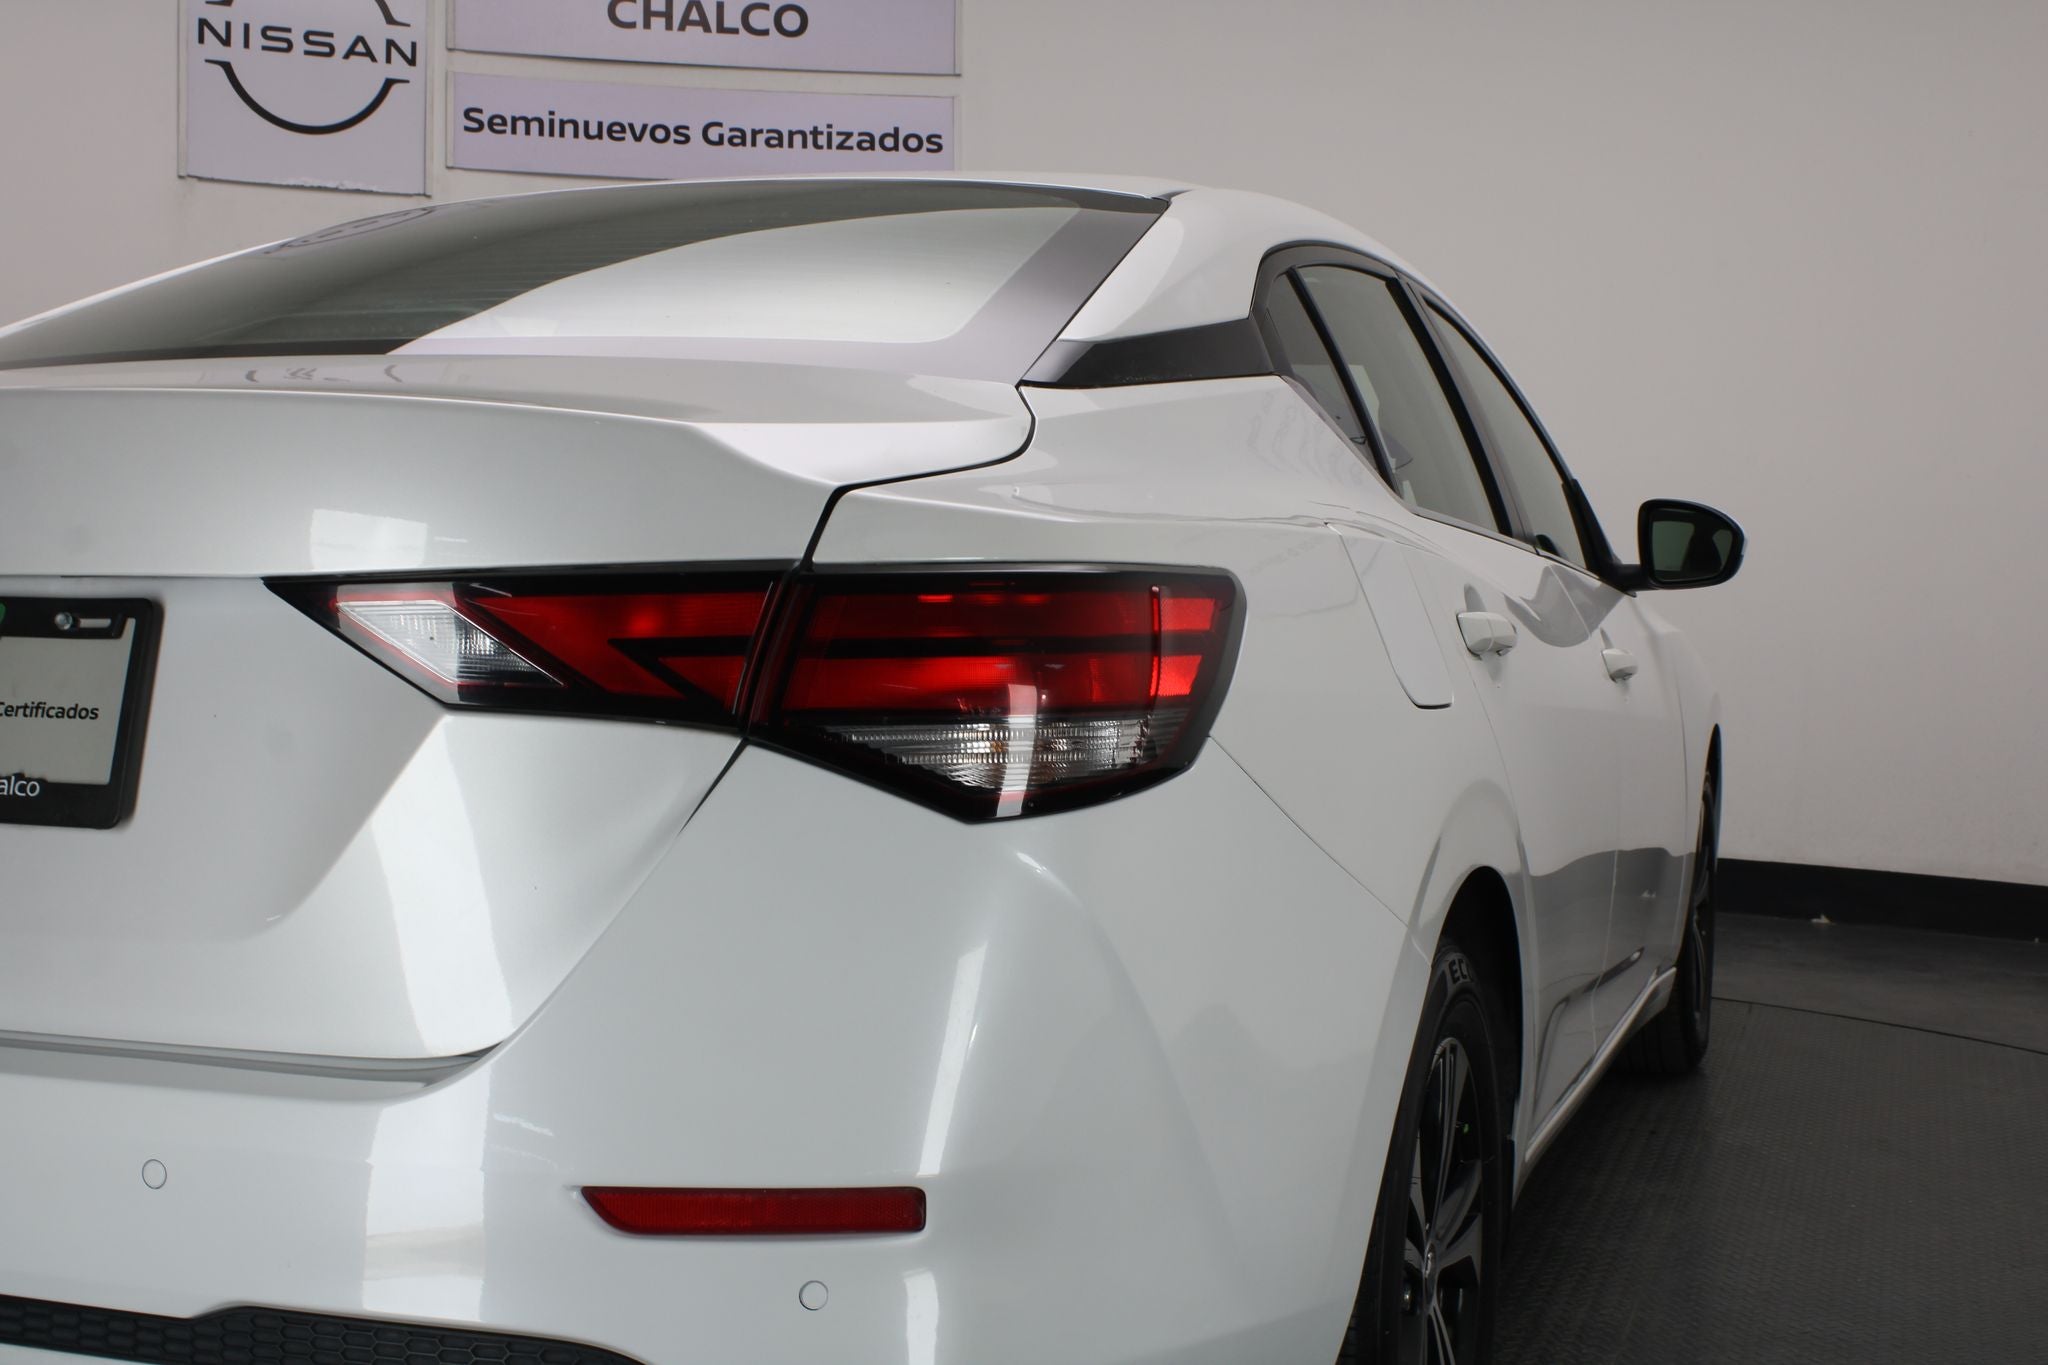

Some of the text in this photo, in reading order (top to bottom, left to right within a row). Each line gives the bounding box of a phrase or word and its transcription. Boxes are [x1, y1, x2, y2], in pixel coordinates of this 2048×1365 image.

[198, 17, 416, 67] NISSAN
[607, 0, 808, 38] CHALCO
[463, 107, 944, 154] Seminuevos Garantizados
